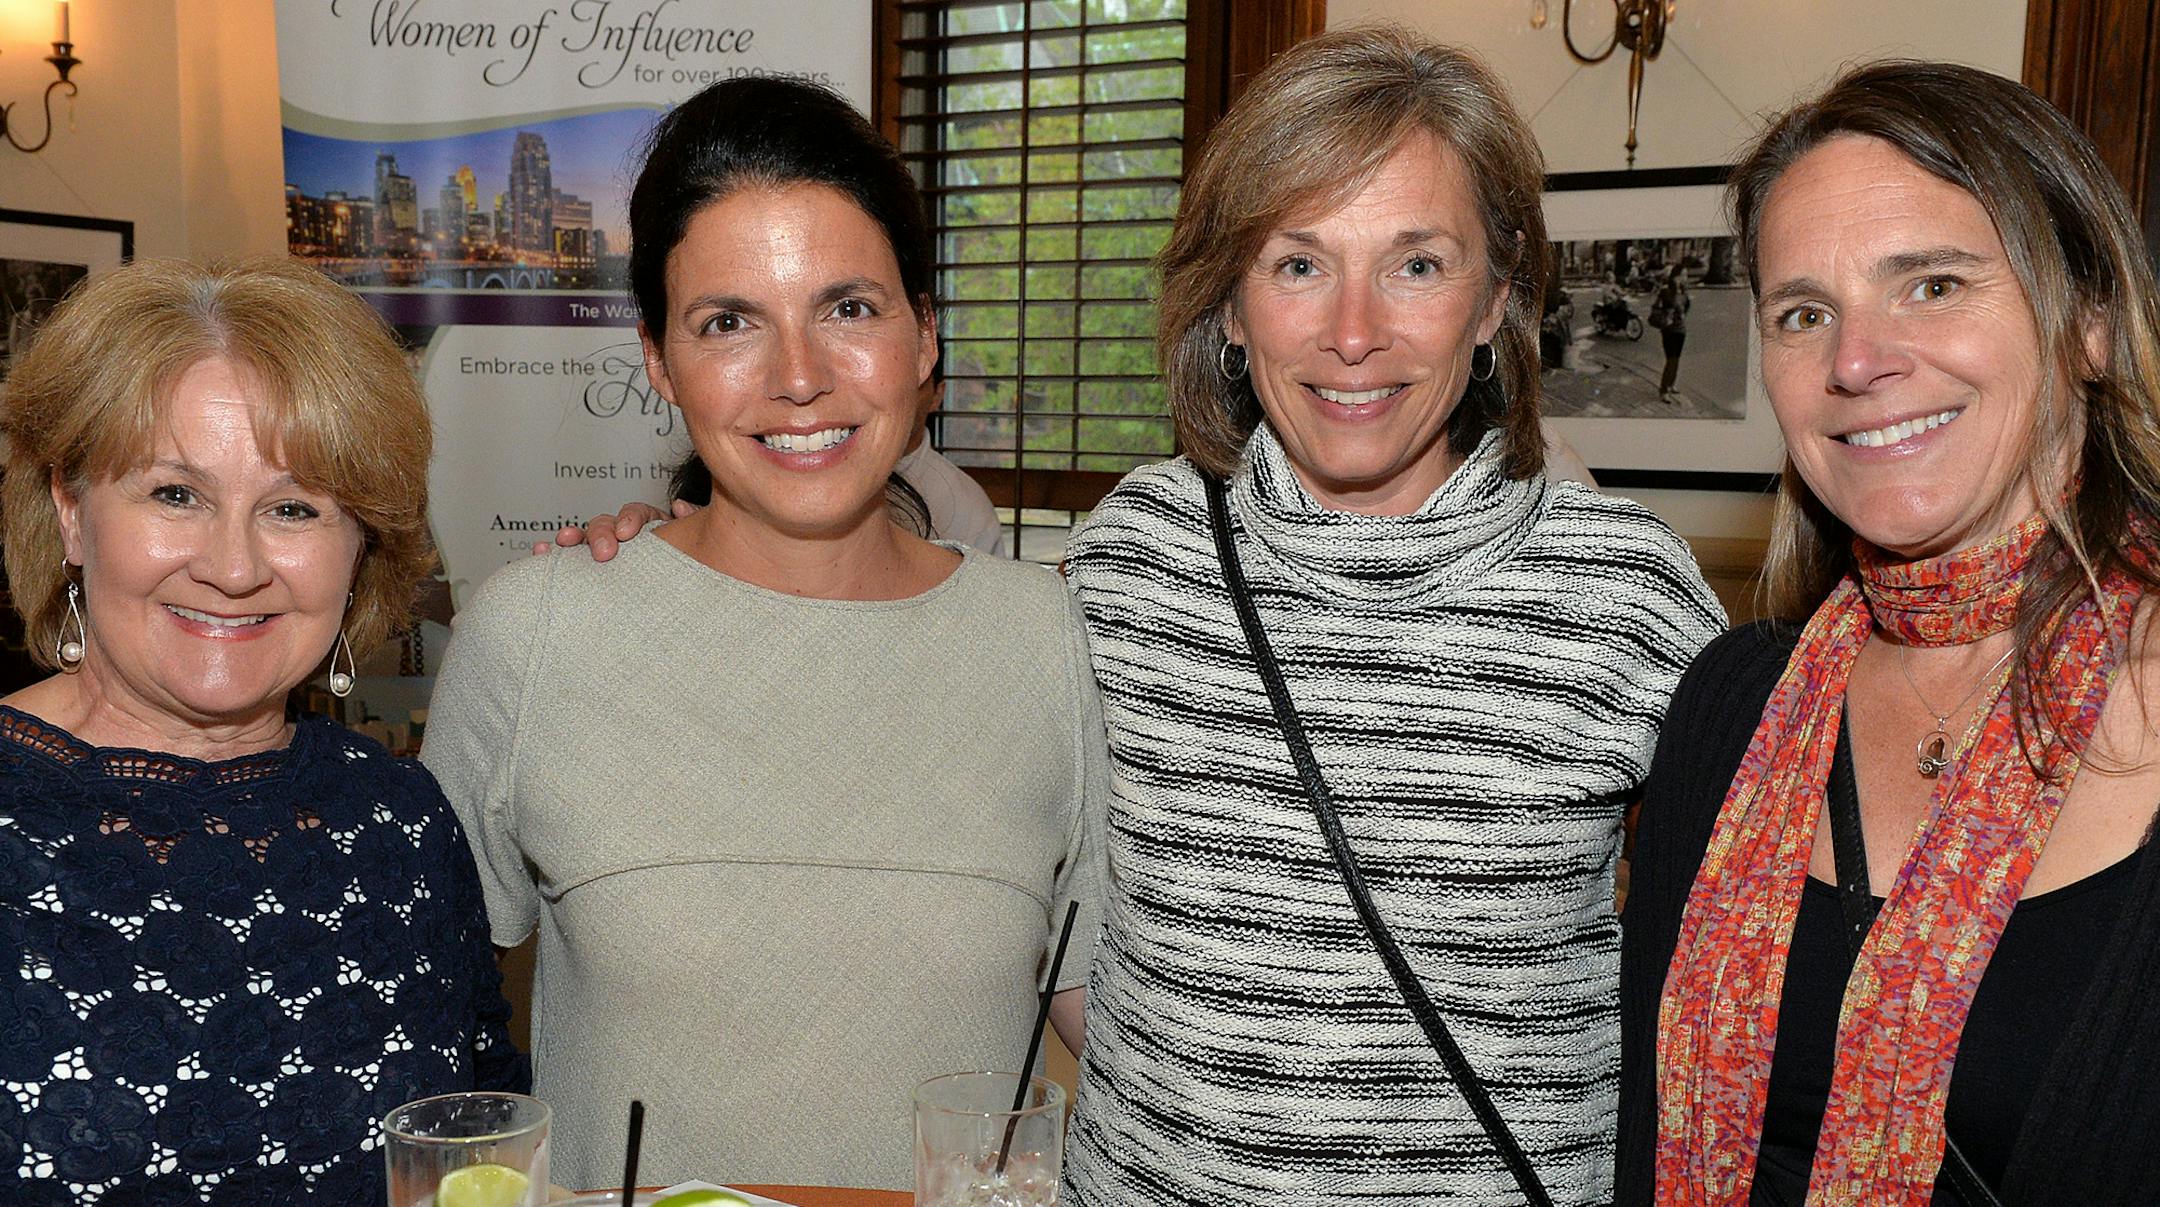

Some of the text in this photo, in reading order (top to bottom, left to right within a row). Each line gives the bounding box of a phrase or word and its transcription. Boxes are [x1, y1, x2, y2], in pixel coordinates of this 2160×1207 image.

[483, 9, 557, 87] of
[561, 0, 754, 88] Influence
[634, 64, 664, 83] for
[671, 67, 719, 84] over
[569, 303, 600, 318] The
[460, 356, 595, 376] Embrace the
[554, 461, 674, 480] Invest in th
